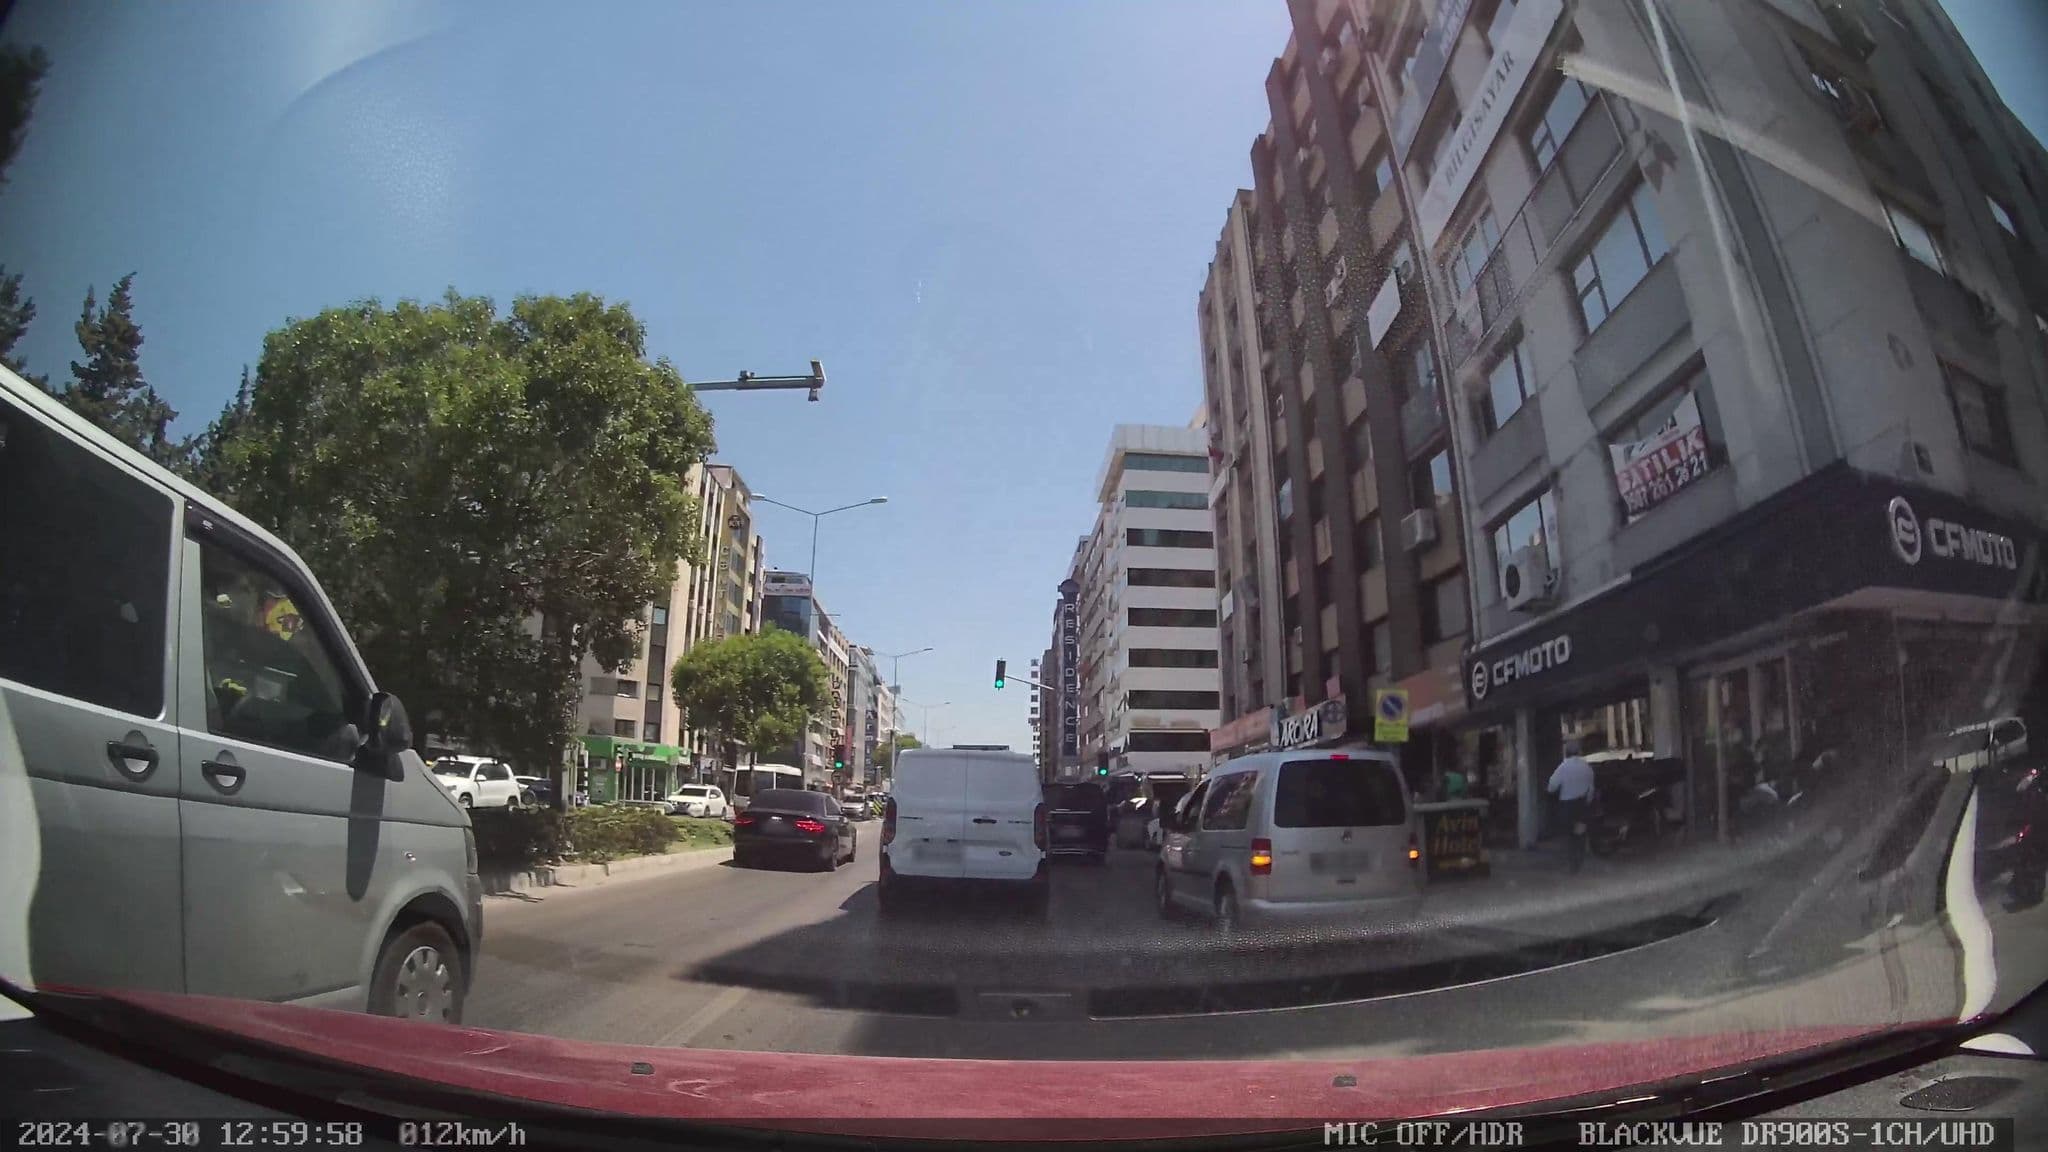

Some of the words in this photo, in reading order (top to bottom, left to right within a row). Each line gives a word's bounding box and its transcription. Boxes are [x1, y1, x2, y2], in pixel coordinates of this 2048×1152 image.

[1928, 518, 2016, 570] CFMOTO
[1064, 603, 1076, 743] RESIDENCE
[1492, 635, 1570, 686] CFMOTO
